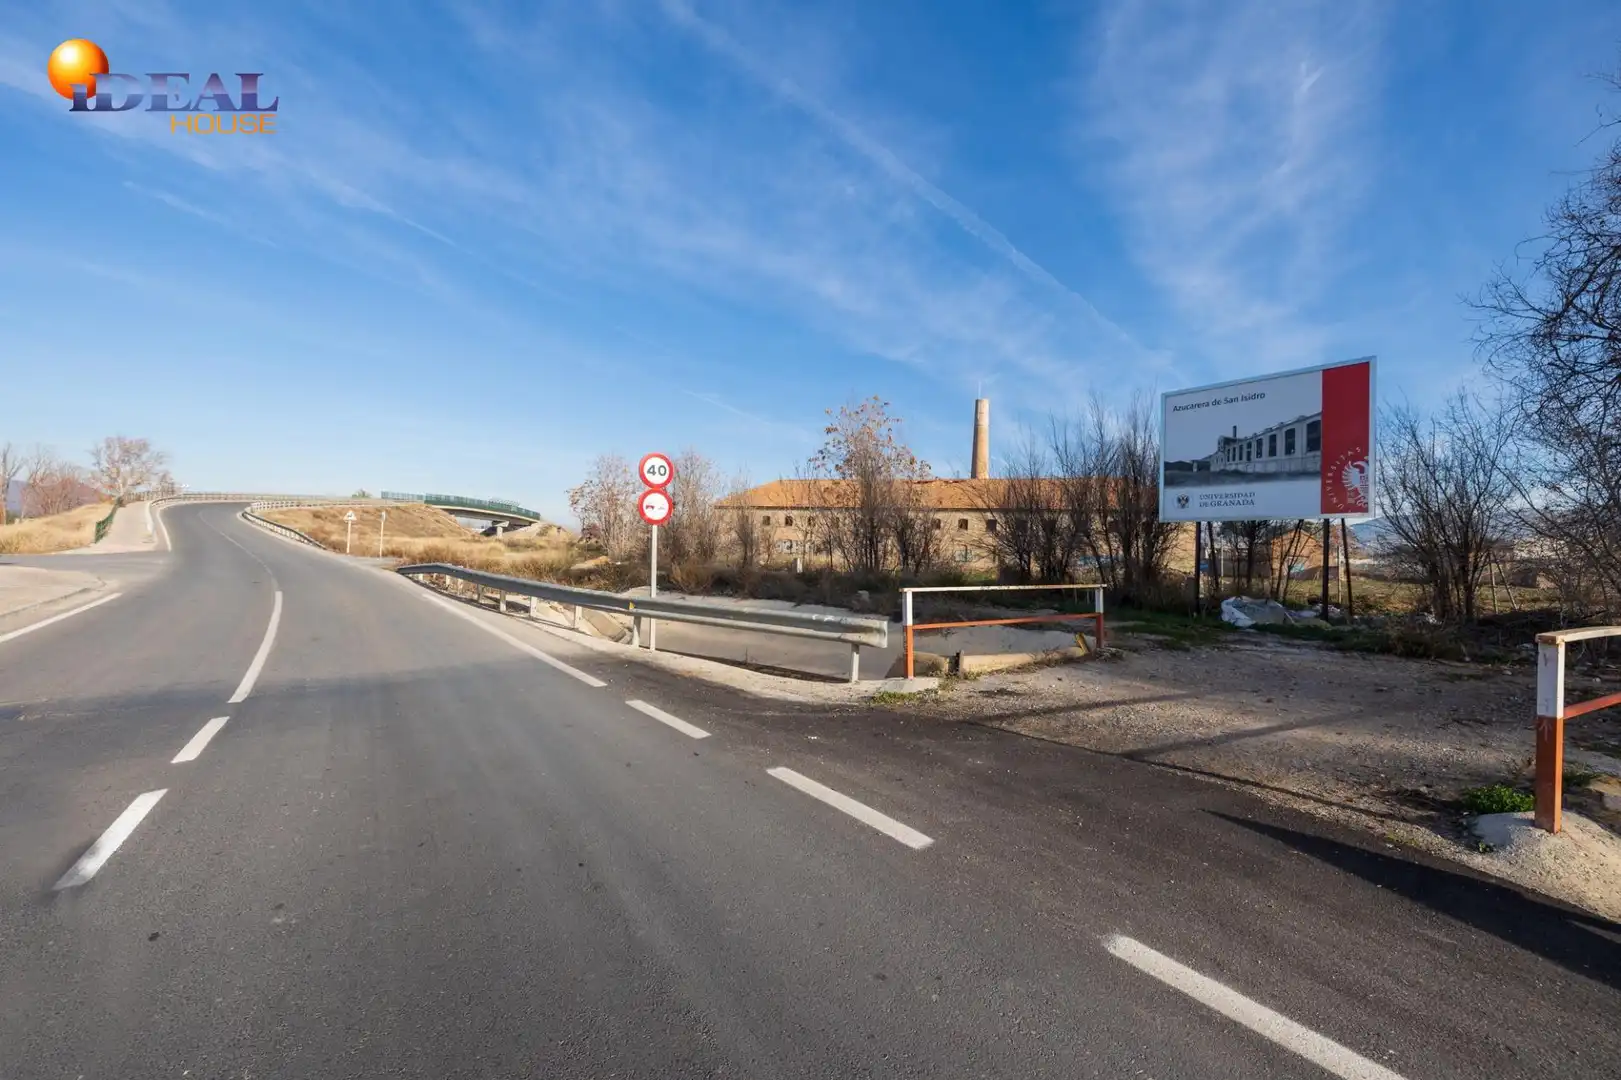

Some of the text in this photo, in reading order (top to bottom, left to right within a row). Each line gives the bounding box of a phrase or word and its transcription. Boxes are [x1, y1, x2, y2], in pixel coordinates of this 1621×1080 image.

[1172, 392, 1266, 412] Azucarera de San Isidro
[647, 465, 667, 476] 40
[1199, 492, 1256, 500] UNIVERSIDAD
[1210, 499, 1255, 508] GRANADA
